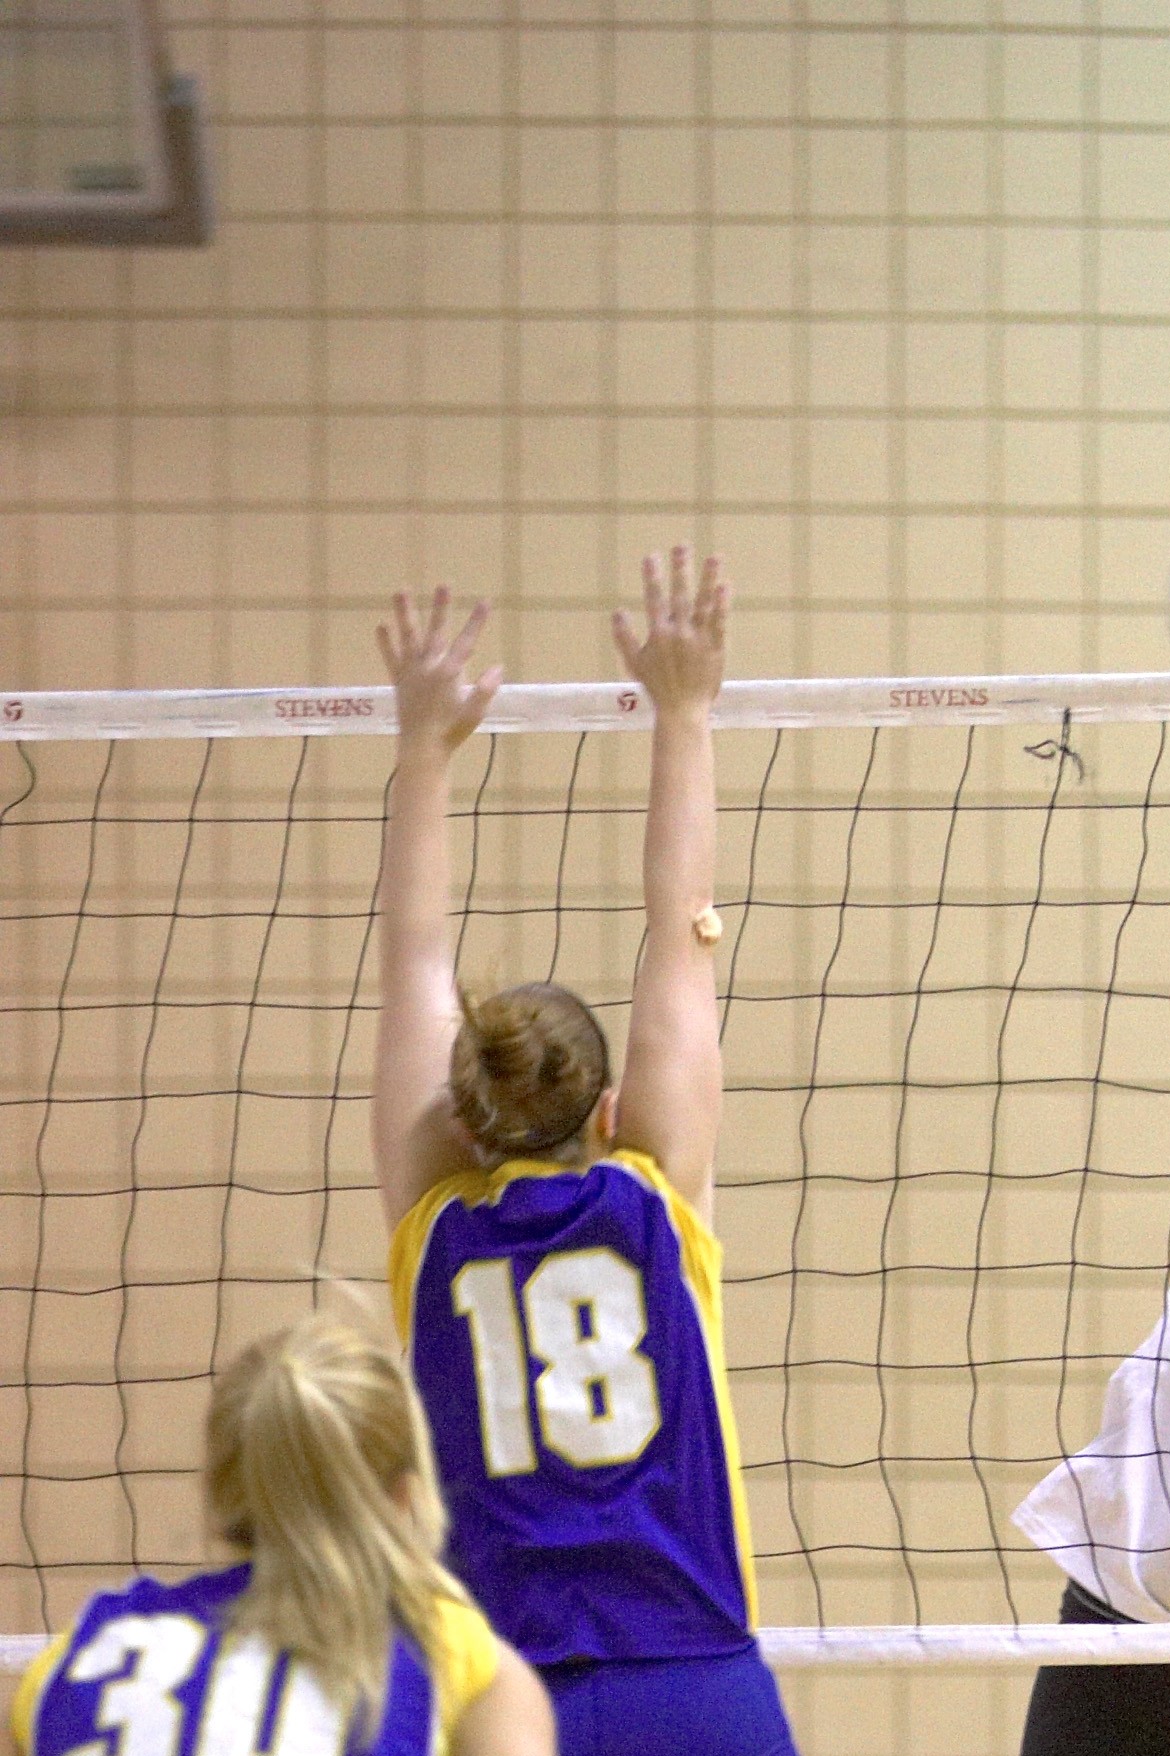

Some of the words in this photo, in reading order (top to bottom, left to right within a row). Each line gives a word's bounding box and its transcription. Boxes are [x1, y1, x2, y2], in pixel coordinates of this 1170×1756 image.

[888, 688, 989, 707] STEVENS
[274, 698, 374, 718] STEVENS
[451, 1246, 663, 1479] 18
